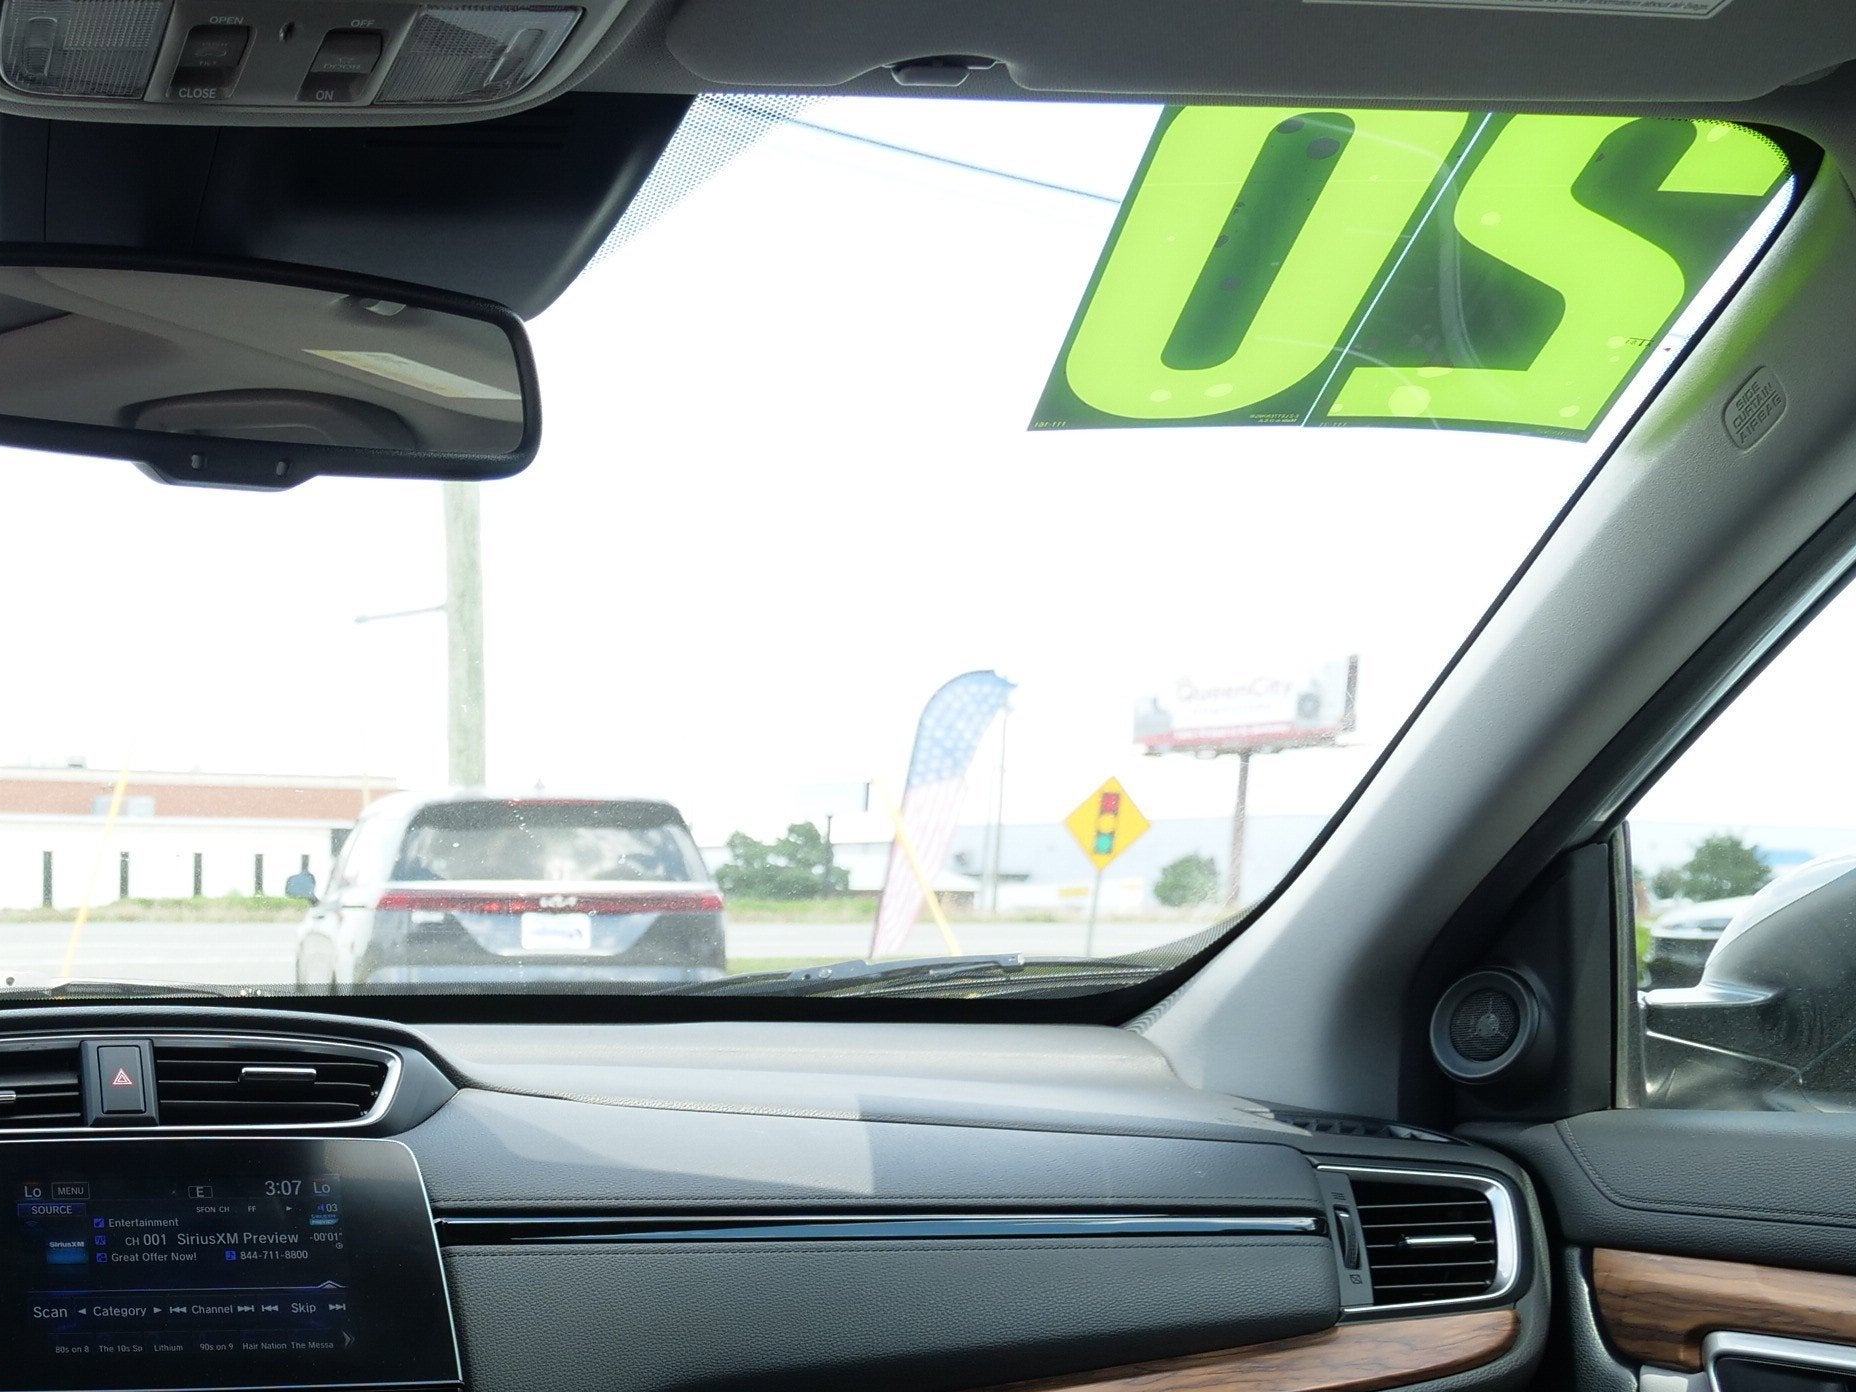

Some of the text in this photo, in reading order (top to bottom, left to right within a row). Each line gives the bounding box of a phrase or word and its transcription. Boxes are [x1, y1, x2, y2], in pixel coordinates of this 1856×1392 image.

[209, 16, 244, 25] OPEN
[351, 19, 375, 27] OFF
[179, 88, 217, 99] CLOSE
[316, 90, 334, 100] ON
[24, 1185, 42, 1198] Lo
[57, 1186, 84, 1196] MENU
[264, 1180, 302, 1196] 3:07
[313, 1181, 331, 1194] Lo
[31, 1205, 73, 1215] SOURCE
[325, 1203, 338, 1212] 03
[108, 1217, 180, 1228] Entertainment
[124, 1231, 300, 1246] CH 001 SiriusXM Preview
[111, 1251, 197, 1263] Great Offer Now!
[240, 1250, 309, 1260] 844-711-8800
[32, 1306, 68, 1318] Scan
[93, 1305, 147, 1319] Category
[191, 1304, 234, 1315] Channel
[291, 1302, 317, 1314] Skip
[99, 1345, 114, 1353] The
[153, 1343, 184, 1352] Lithium
[199, 1342, 234, 1351] 90s on 9
[242, 1342, 287, 1350] Hair Nation
[291, 1341, 334, 1349] The Messa
